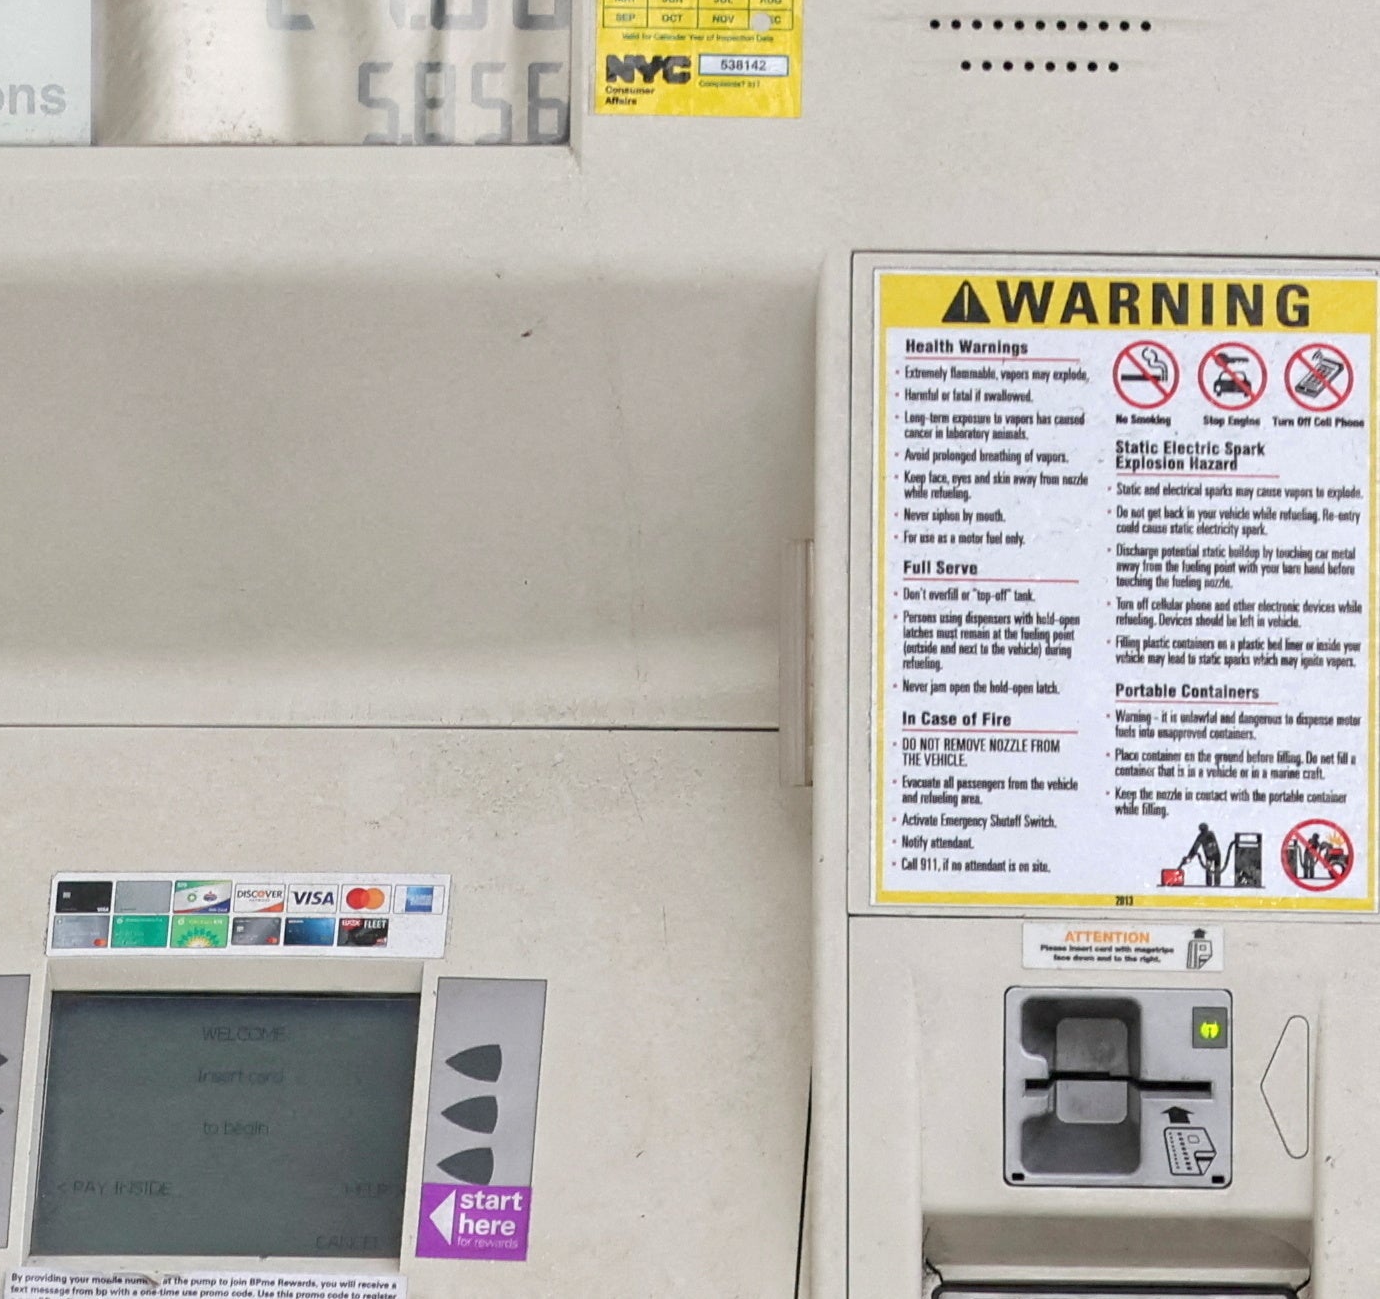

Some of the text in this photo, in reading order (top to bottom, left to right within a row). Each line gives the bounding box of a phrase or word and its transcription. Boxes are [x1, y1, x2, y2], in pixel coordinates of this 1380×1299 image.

[606, 55, 692, 84] NYC
[605, 97, 637, 106] Affairs
[996, 280, 1310, 327] WARNING
[906, 338, 1028, 356] Health Warnings
[1116, 414, 1171, 427] No Smoking
[1116, 441, 1265, 459] Static Electric Spark
[1116, 456, 1238, 472] Explosion Hazard
[904, 560, 977, 575] Full Serve
[1116, 683, 1259, 699] Portable Containers
[903, 711, 1011, 726] In Case of Fire
[902, 737, 1060, 753] DO NOT REMOVE NOZZLE FROM
[903, 752, 967, 767] THE VEHICLE.
[237, 890, 282, 898] DISCOVER
[292, 891, 334, 905] VISA
[1115, 896, 1133, 906] 2013
[364, 920, 387, 929] FLEET
[1065, 931, 1151, 943] ATTENTION
[460, 1190, 523, 1211] start
[458, 1213, 516, 1236] here
[457, 1236, 518, 1249] for rewards
[11, 1273, 90, 1285] By providing your
